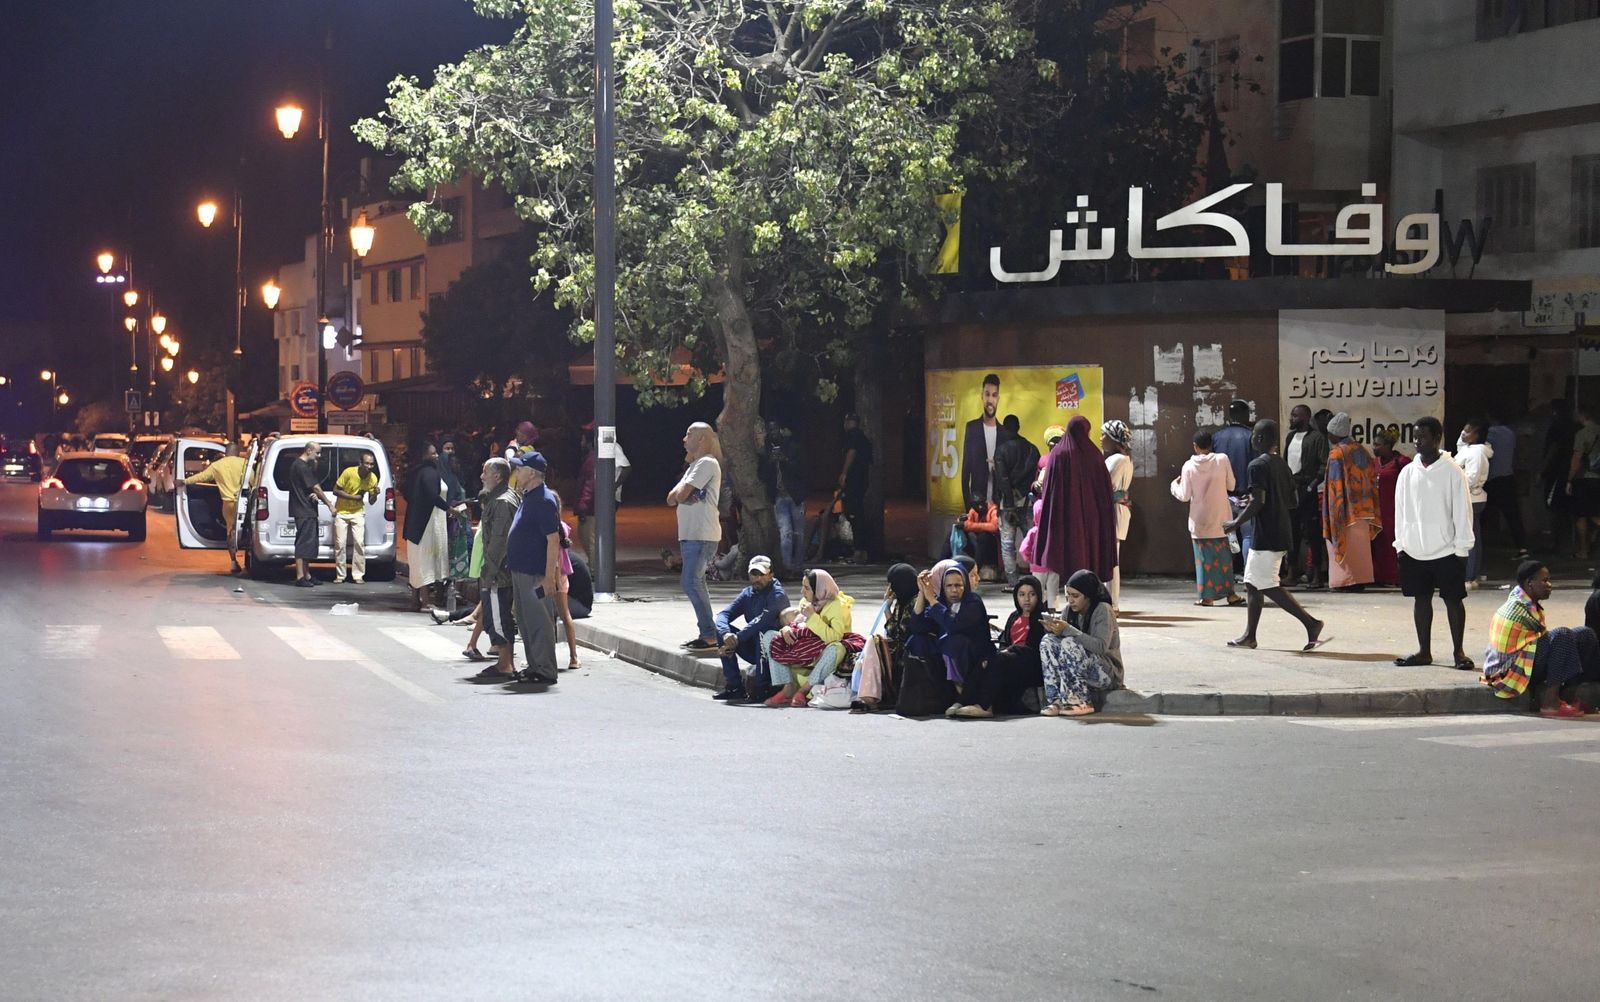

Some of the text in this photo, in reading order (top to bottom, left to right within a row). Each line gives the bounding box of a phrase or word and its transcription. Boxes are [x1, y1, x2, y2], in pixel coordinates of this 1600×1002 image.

[990, 182, 1440, 282] وفاكاش
[1057, 400, 1079, 409] 2023
[1288, 373, 1439, 399] Bienvenue
[930, 428, 958, 478] 25
